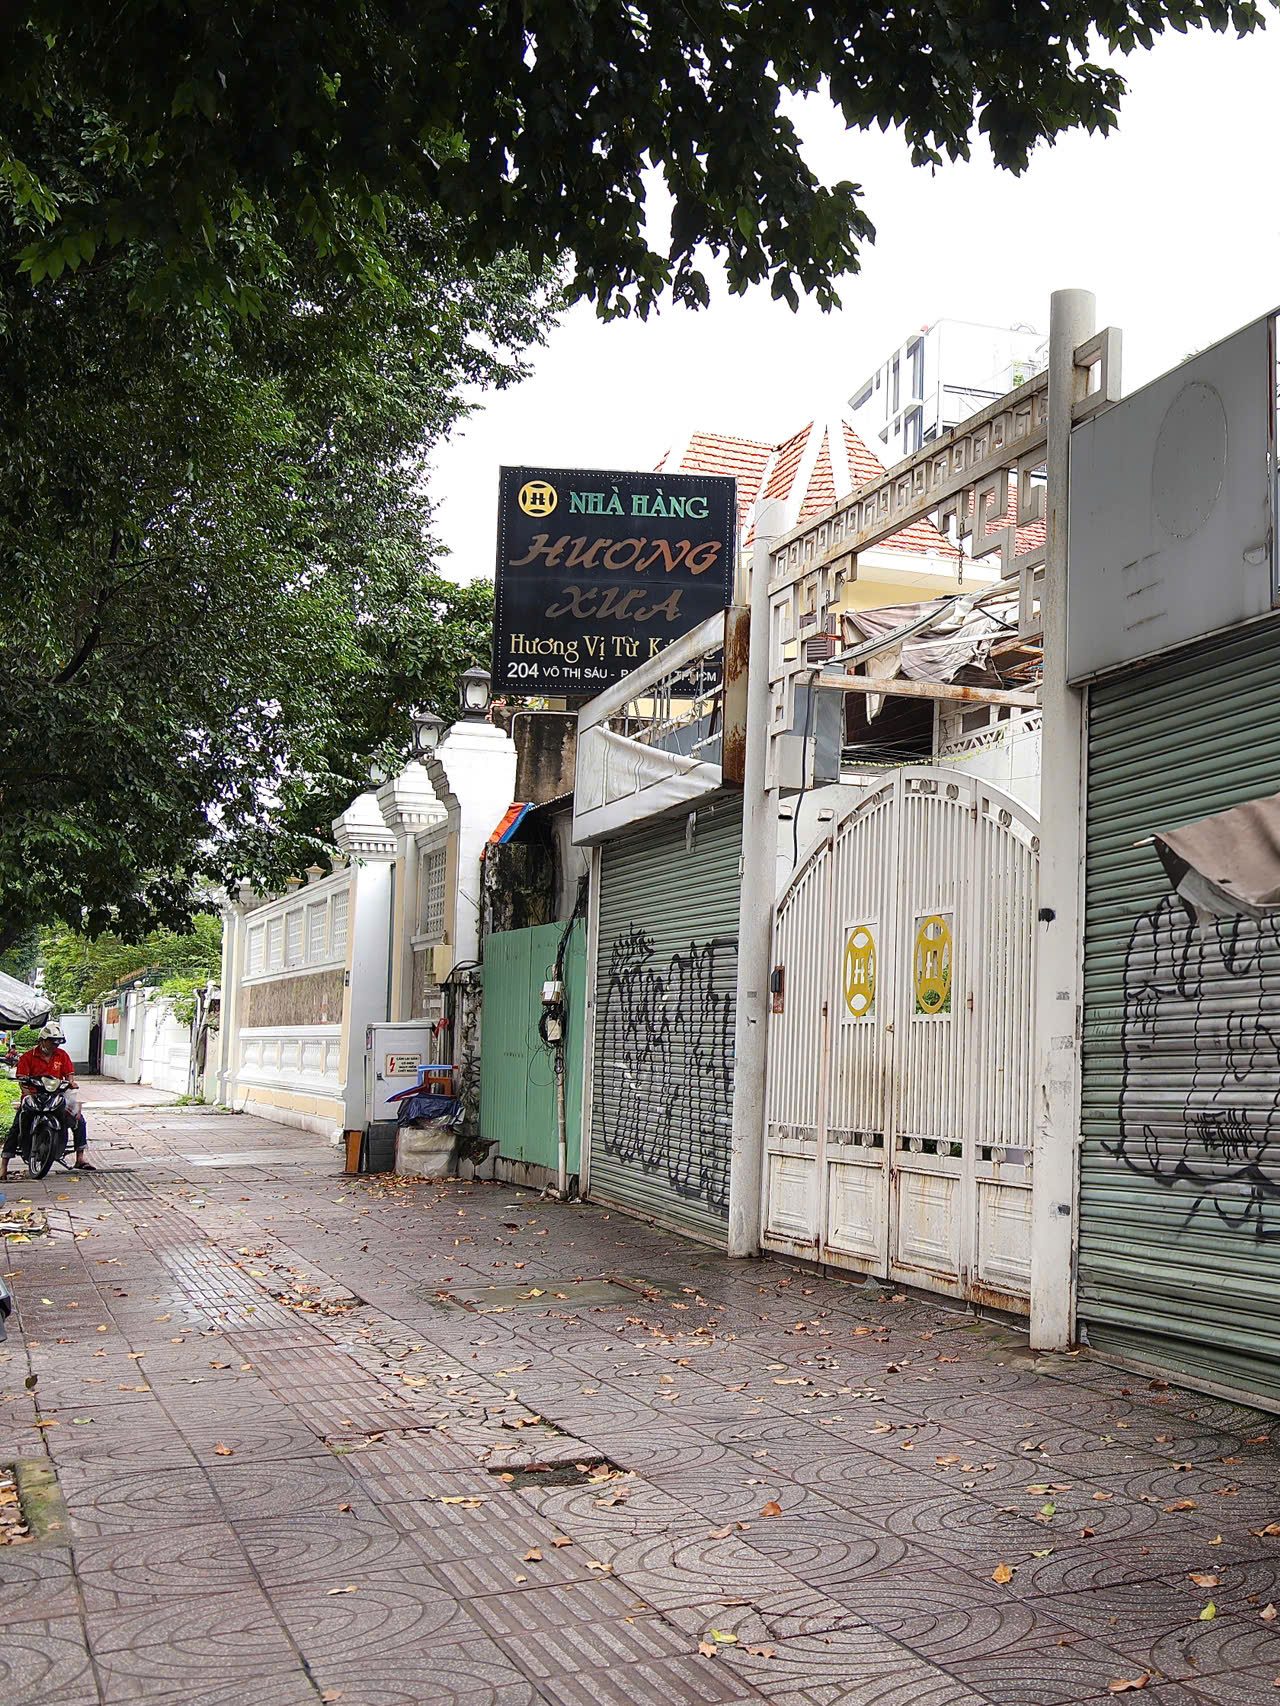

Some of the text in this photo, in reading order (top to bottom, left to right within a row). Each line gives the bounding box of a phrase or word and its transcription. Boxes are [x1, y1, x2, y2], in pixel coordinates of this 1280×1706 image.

[569, 486, 709, 519] NHÀ HÀNG
[510, 633, 579, 664] Hương
[583, 635, 605, 661] Vị
[611, 635, 640, 657] Từ
[507, 662, 540, 679] 204
[543, 664, 560, 678] VÕ
[563, 667, 581, 680] THỊ
[584, 664, 608, 679] SÁU
